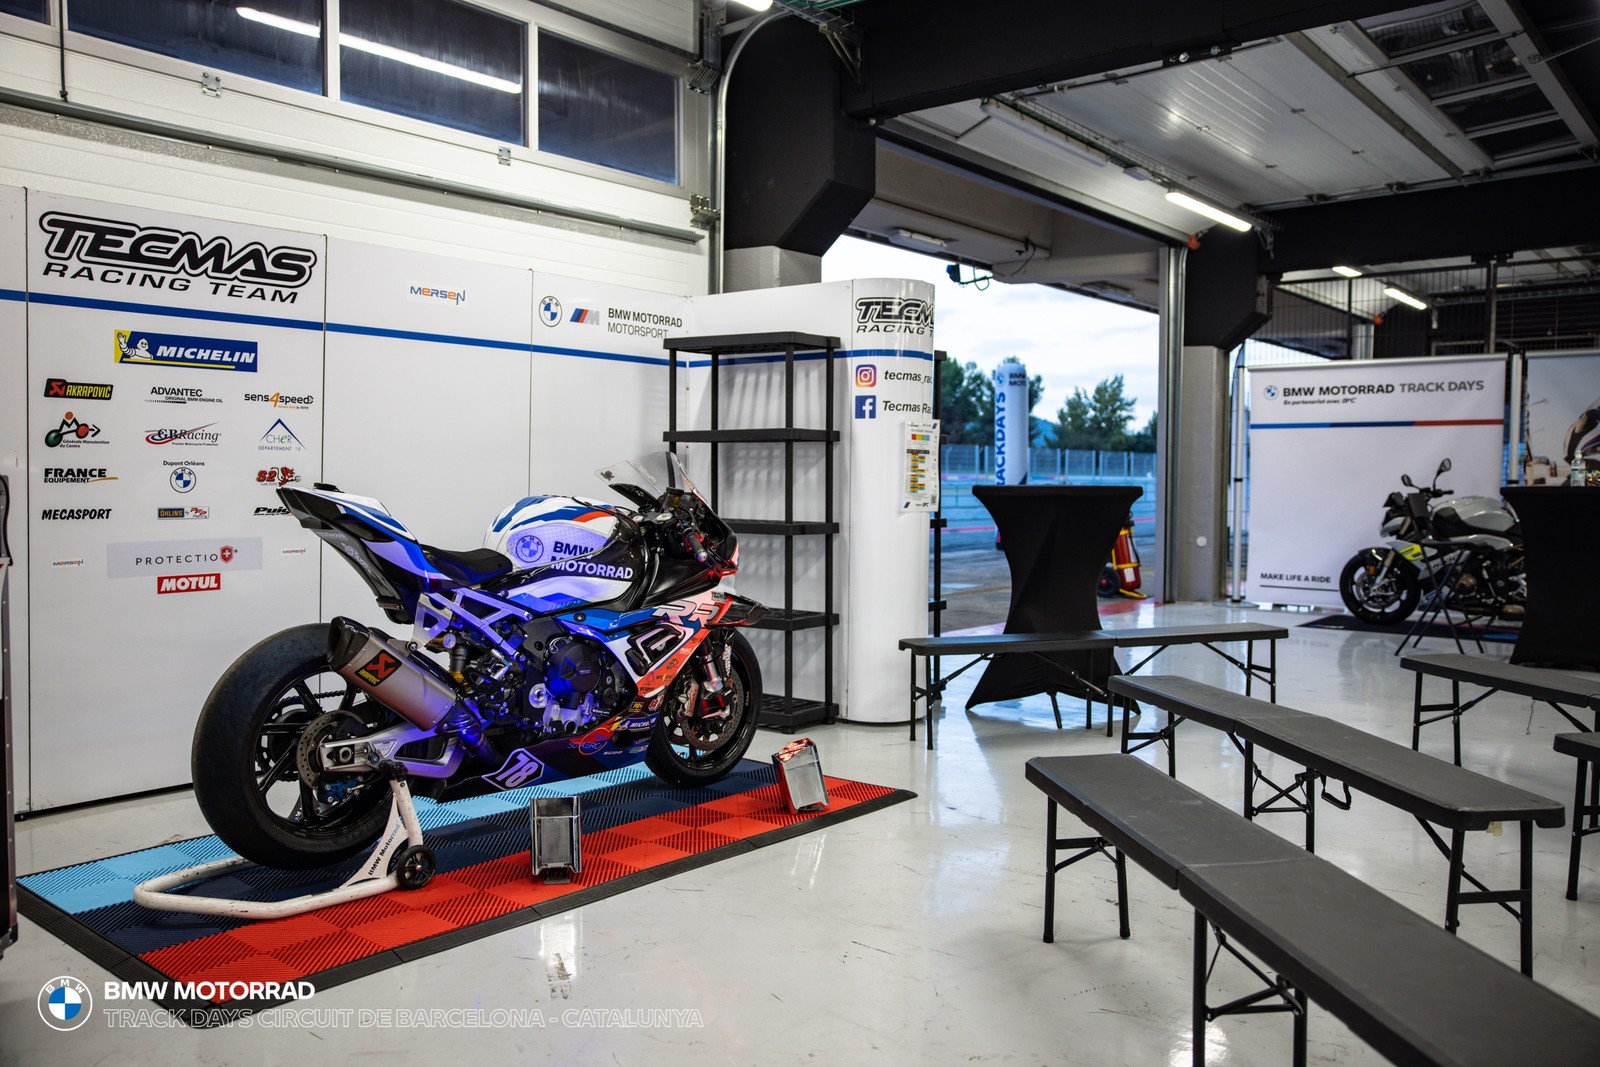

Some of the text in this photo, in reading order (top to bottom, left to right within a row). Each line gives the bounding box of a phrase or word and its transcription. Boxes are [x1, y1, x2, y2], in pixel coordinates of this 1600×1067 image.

[39, 211, 317, 288] TECMAS
[42, 262, 298, 304] RACING TEAM
[608, 307, 683, 328] BMW MOTORRAD
[607, 321, 669, 339] MOTORSPORT
[856, 324, 925, 336] RACING
[156, 345, 256, 364] MICHELIN
[150, 386, 203, 397] ADVANTEC
[1283, 380, 1485, 397] BMW MOTORRAD TRACK DAYS
[882, 400, 921, 413] Tecmas
[157, 428, 219, 443] GBRacing
[44, 467, 107, 478] FRANCE
[41, 508, 113, 521] MECASPORT
[553, 541, 595, 557] BMW
[550, 555, 634, 580] MOTORRAD
[160, 575, 219, 592] MOTUL
[1285, 574, 1303, 582] LIFE
[1311, 575, 1331, 583] RIDE
[495, 752, 539, 788] 78
[379, 823, 401, 858] Motorrad
